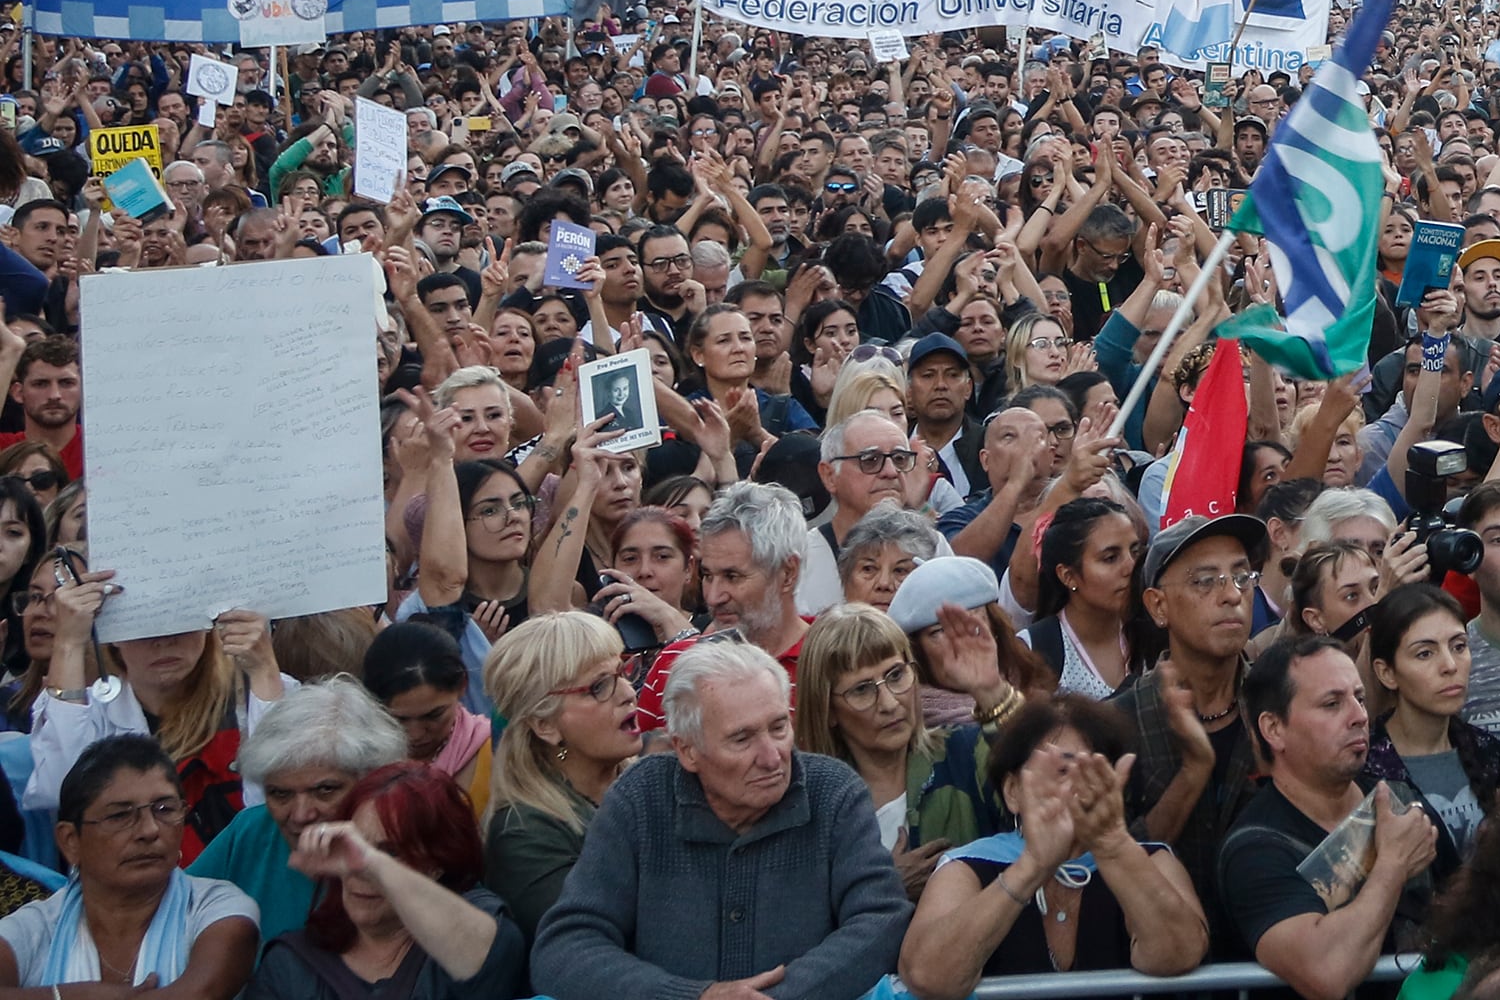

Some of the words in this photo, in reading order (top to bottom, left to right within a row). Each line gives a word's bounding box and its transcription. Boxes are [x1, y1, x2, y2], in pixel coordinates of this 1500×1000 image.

[1142, 22, 1304, 72] Aentina
[97, 131, 154, 155] QUEDA
[556, 231, 591, 248] PERÓN
[1420, 227, 1460, 239] CONSTITUCIÓN
[1417, 235, 1457, 248] NACIONAL
[638, 430, 653, 438] VIDA
